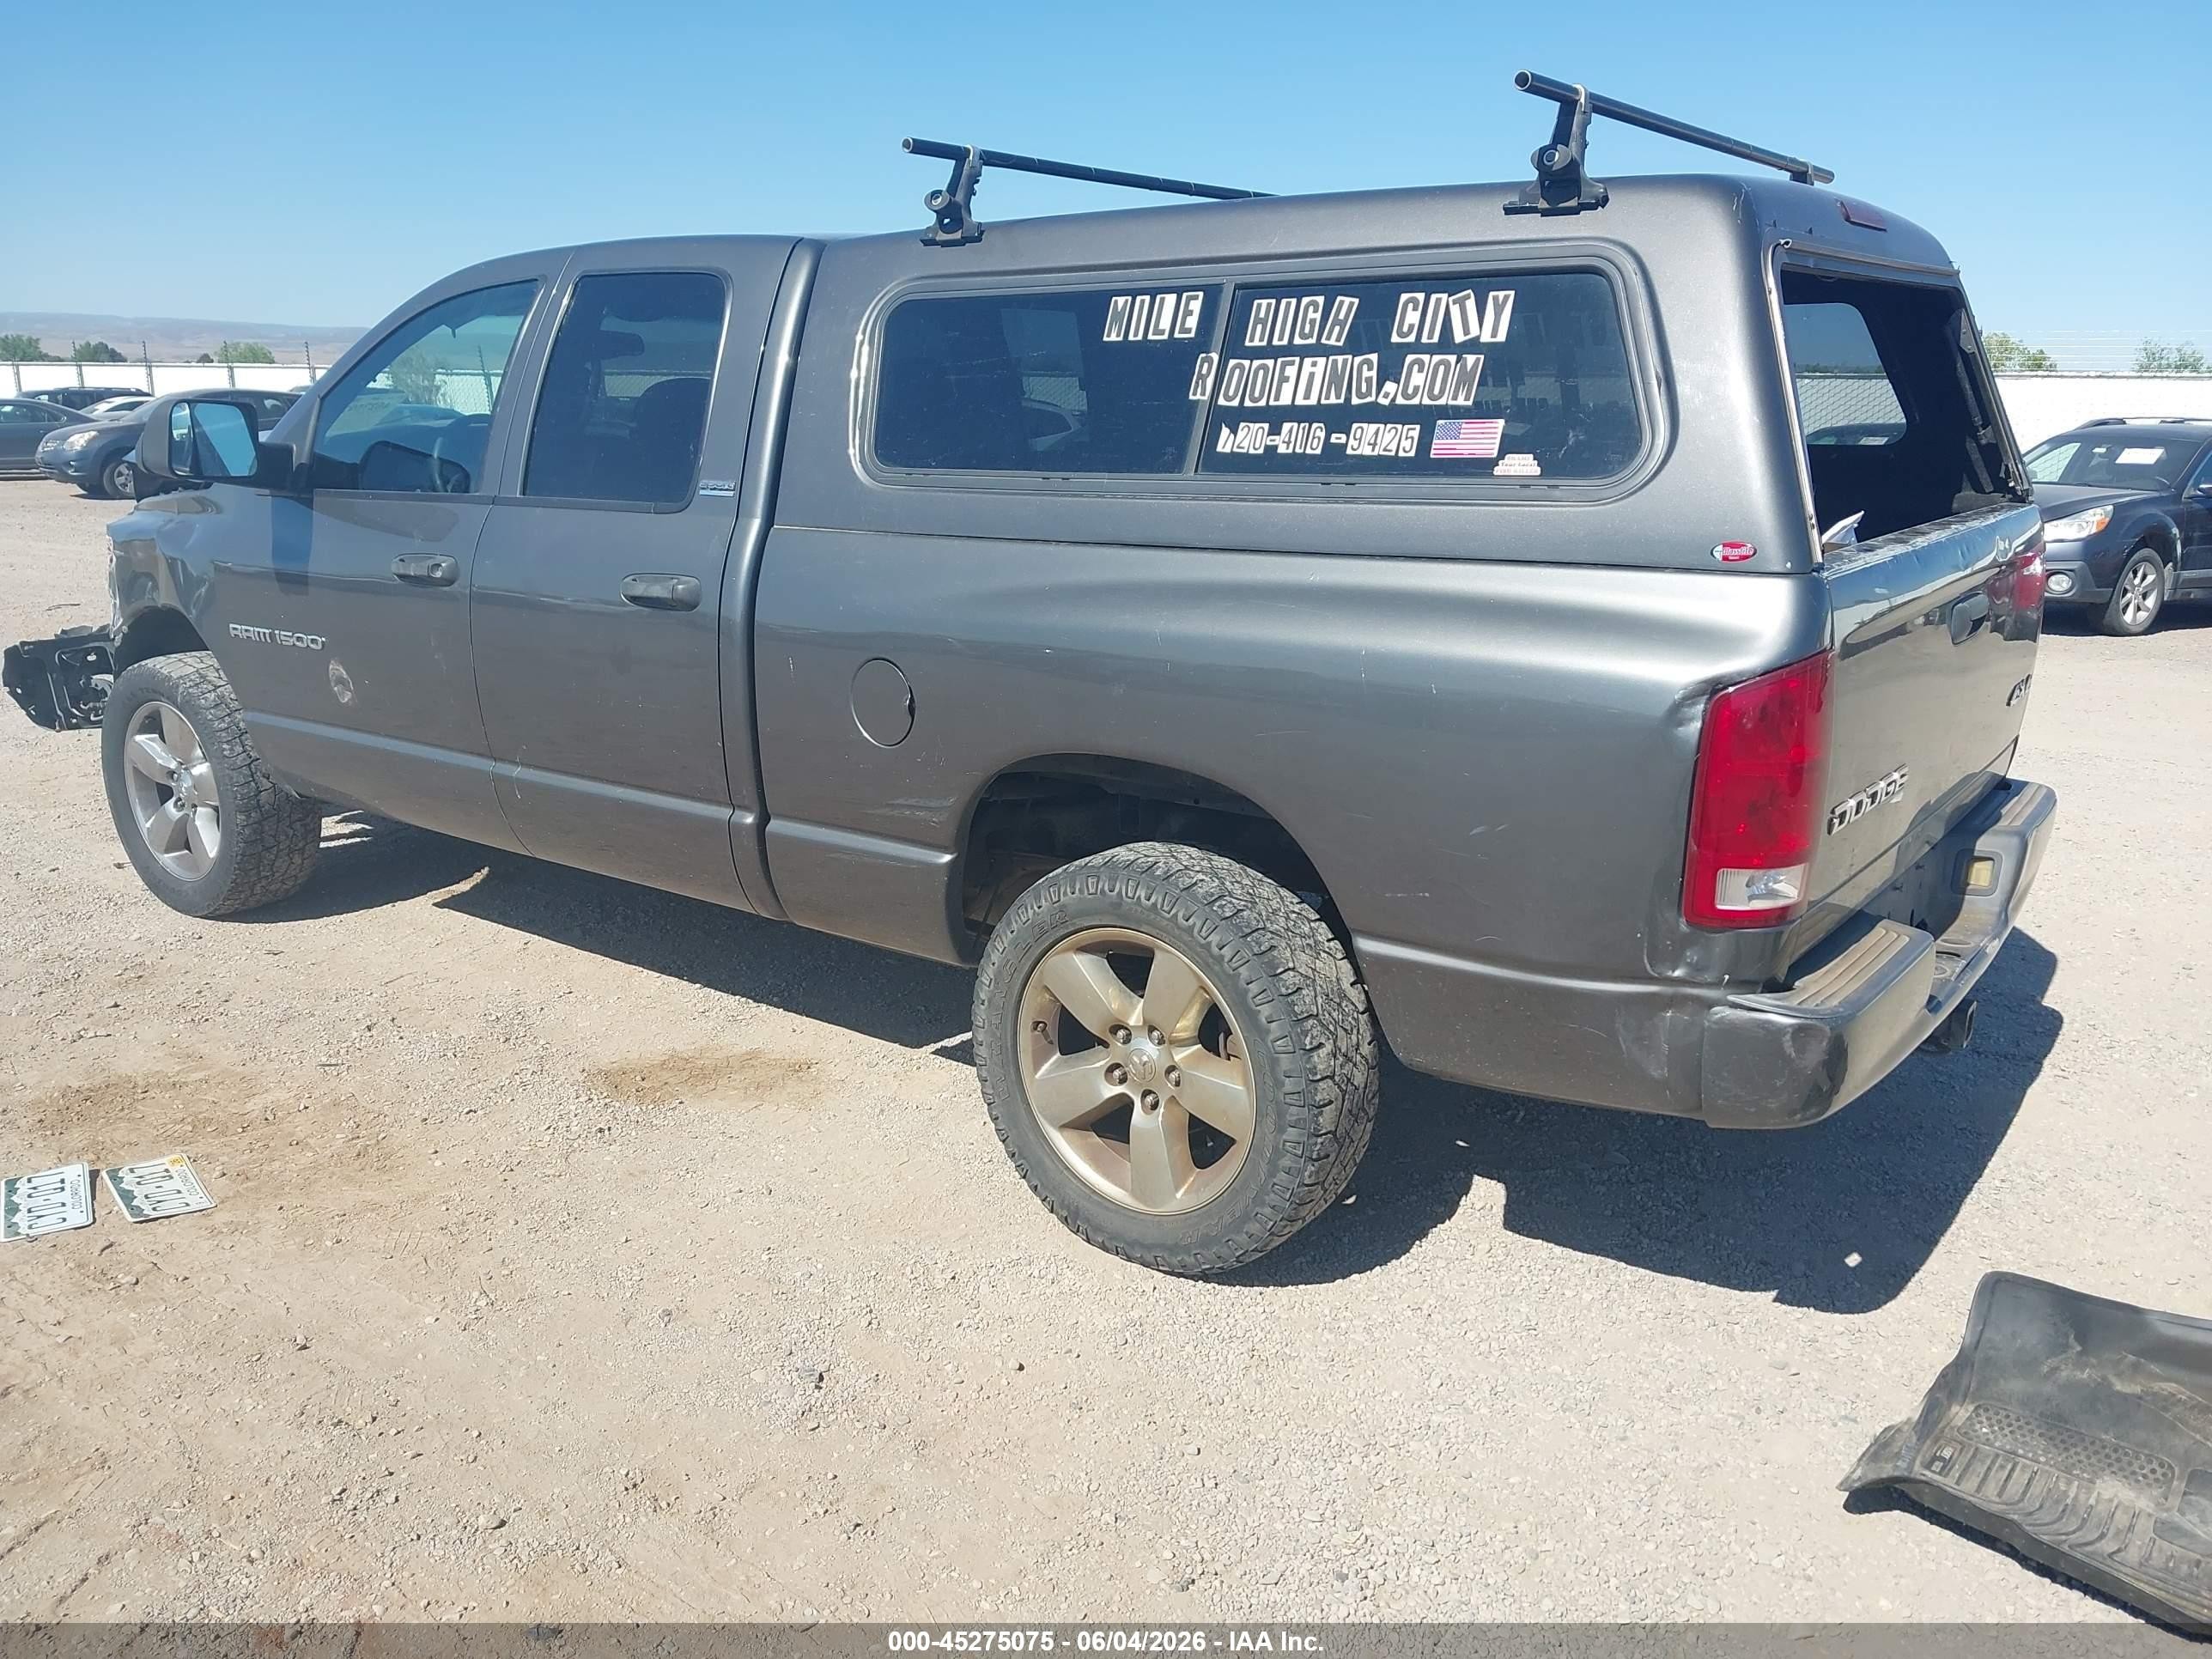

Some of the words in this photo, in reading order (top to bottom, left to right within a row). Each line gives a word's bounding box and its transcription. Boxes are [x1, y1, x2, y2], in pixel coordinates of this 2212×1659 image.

[1105, 294, 1200, 338] MILE
[1248, 298, 1356, 343] HIGH
[1395, 292, 1512, 340] CITY
[228, 623, 272, 644] RAM
[274, 629, 324, 651] 1500
[1826, 763, 1910, 836] DODGE
[71, 1179, 82, 1211] COLORADO
[175, 1169, 200, 1197] COLORADO
